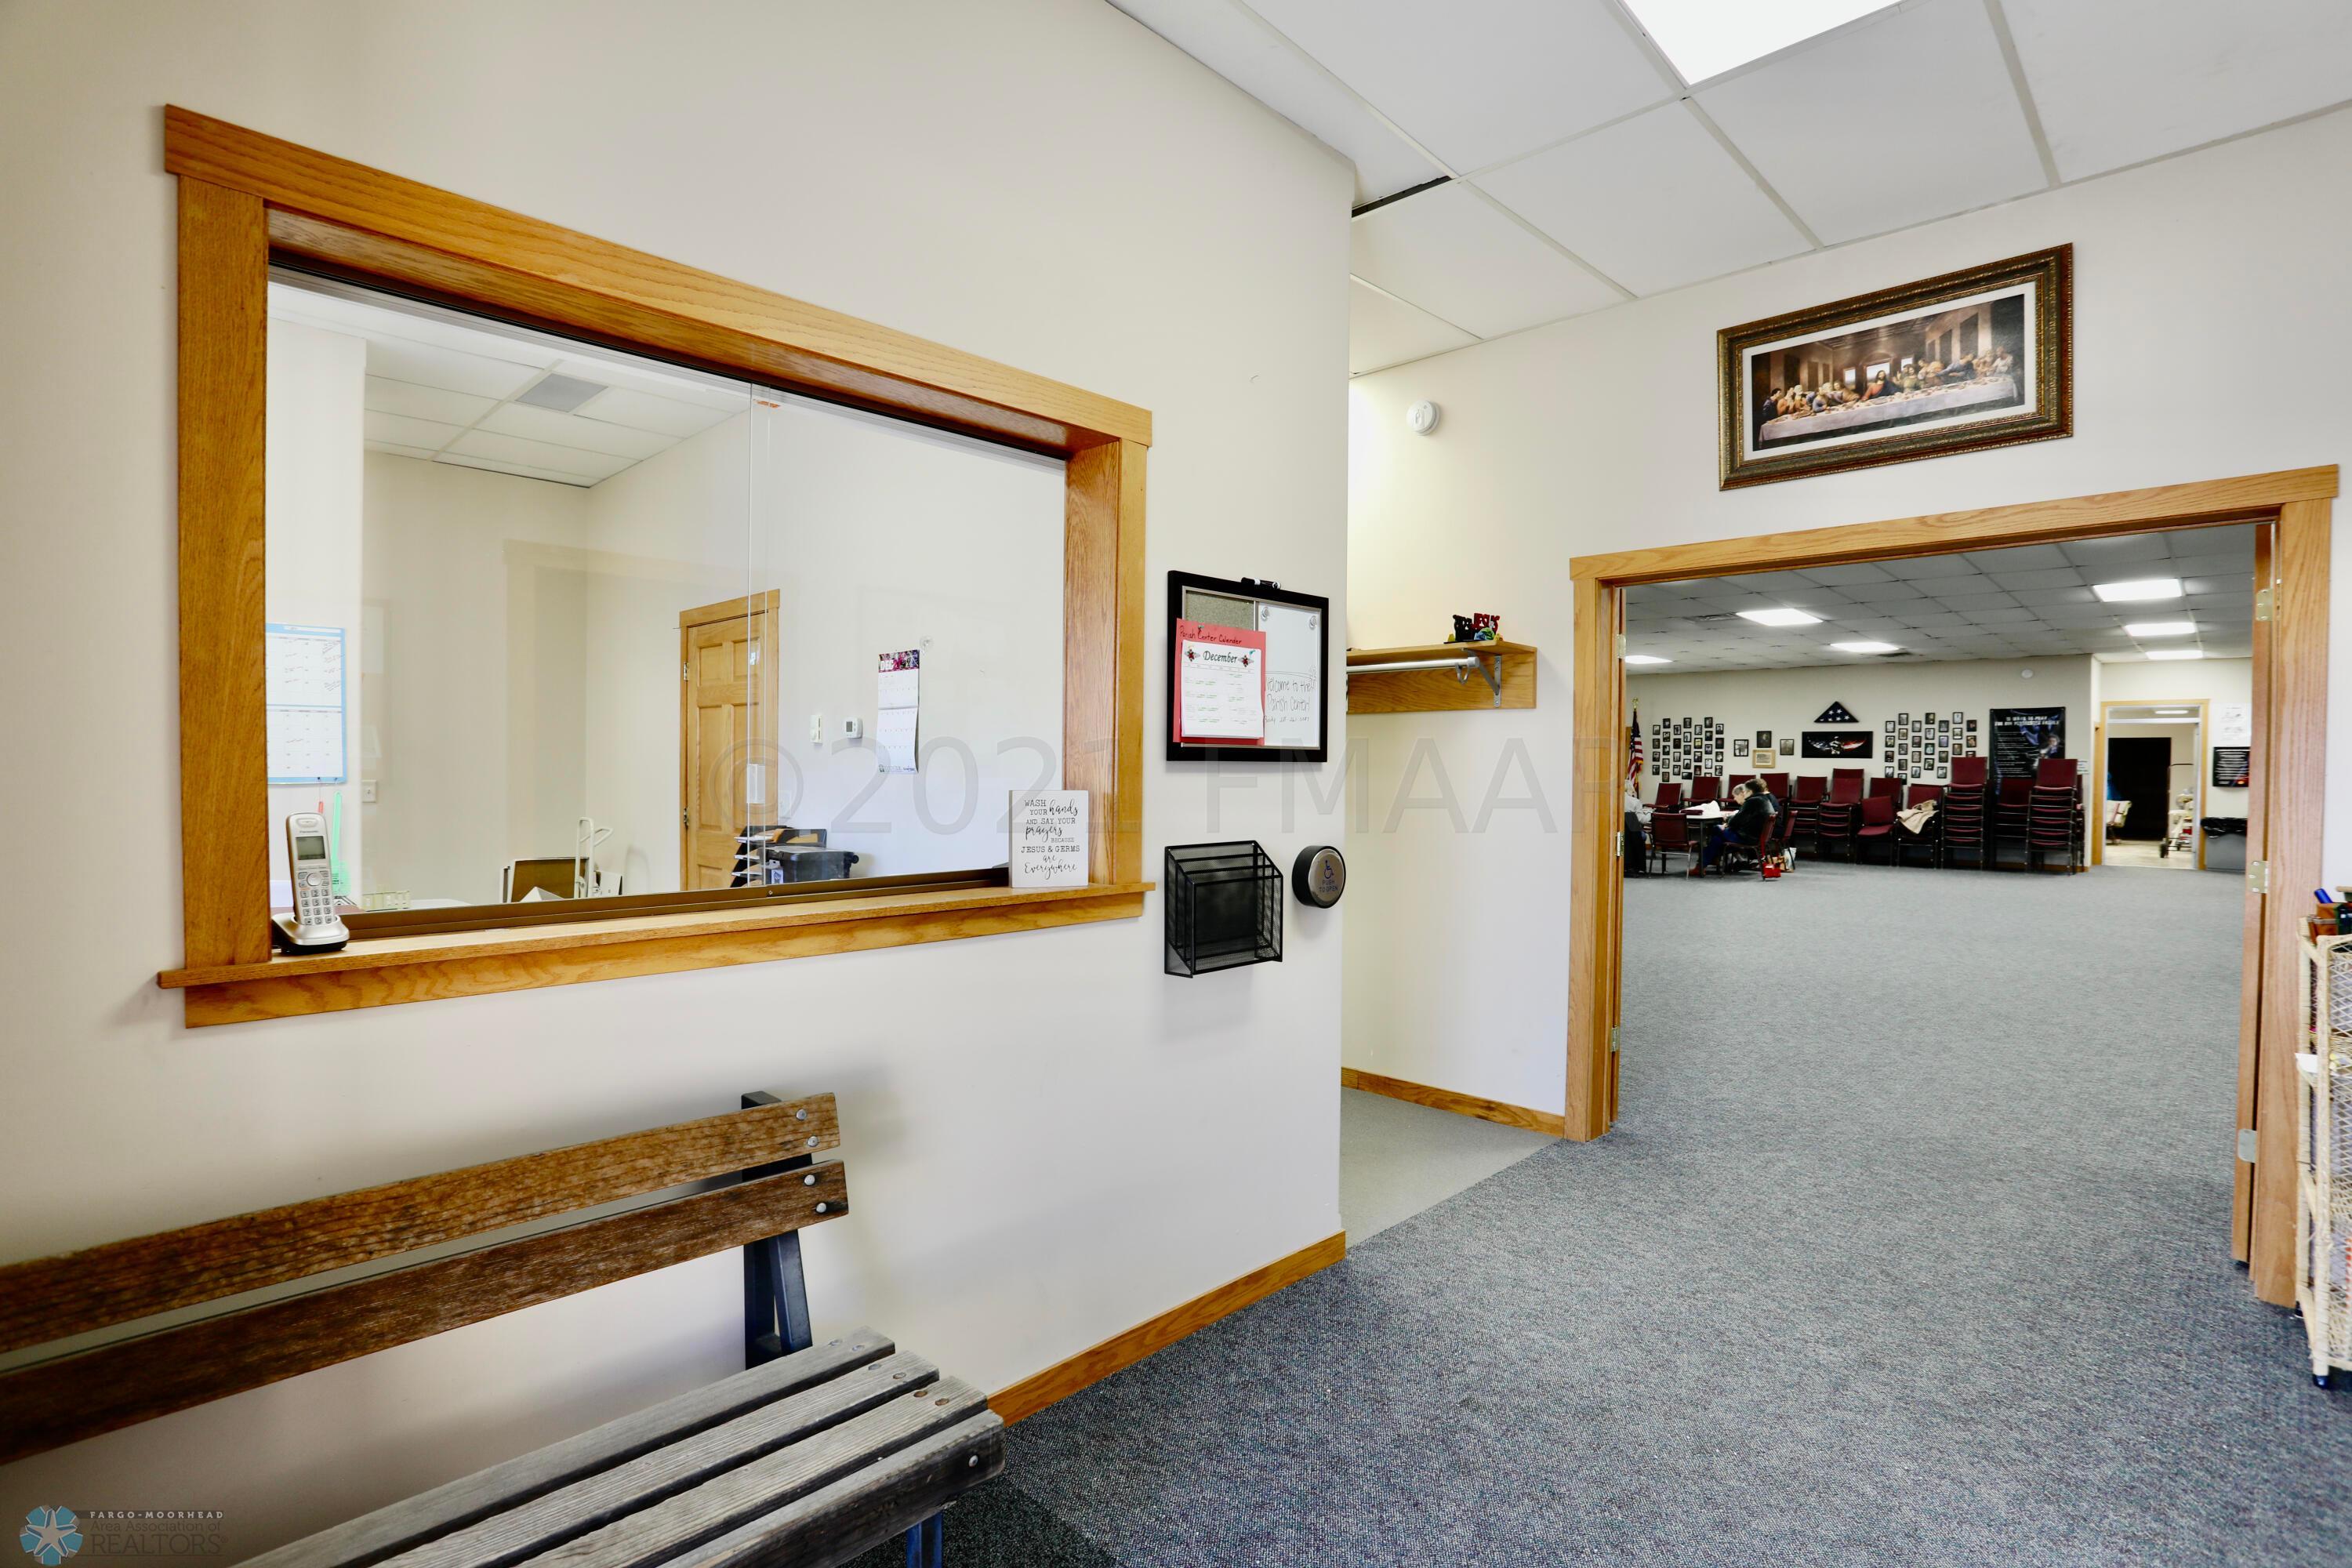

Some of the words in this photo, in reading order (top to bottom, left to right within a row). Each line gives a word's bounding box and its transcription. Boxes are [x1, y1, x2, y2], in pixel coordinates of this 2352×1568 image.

[1179, 625, 1196, 638] Parish
[1203, 651, 1237, 663] December
[1049, 799, 1079, 816] hands
[1025, 826, 1063, 842] prayers
[1043, 855, 1056, 863] are
[1024, 859, 1077, 880] Everywhere
